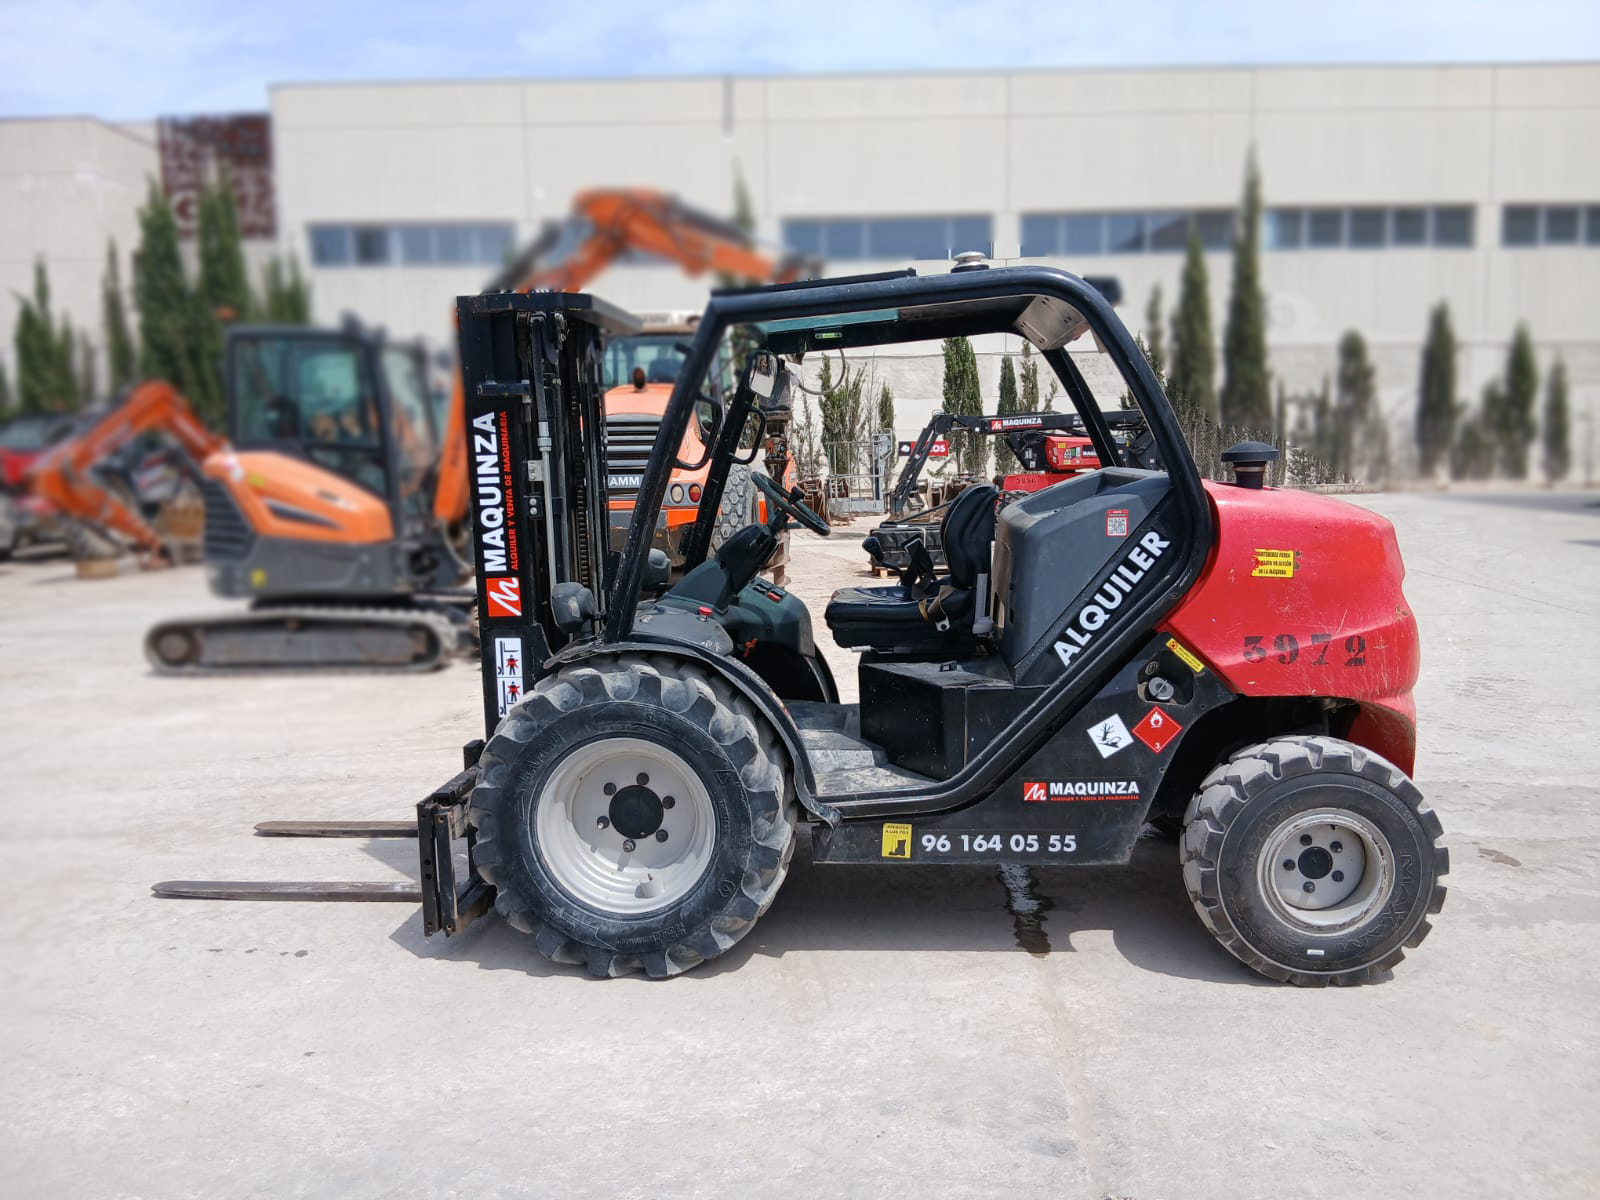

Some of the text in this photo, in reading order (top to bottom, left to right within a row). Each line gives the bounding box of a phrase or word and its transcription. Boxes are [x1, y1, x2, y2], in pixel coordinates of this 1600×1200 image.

[1003, 418, 1042, 426] MAQUINZA
[501, 412, 512, 472] MAQUINARIA
[473, 412, 506, 572] MAQUINZA
[504, 474, 512, 486] DE
[608, 476, 640, 486] AMM
[505, 488, 514, 518] VENTA
[508, 529, 518, 570] ALQUILER
[1053, 530, 1170, 666] ALQUILER
[1243, 634, 1366, 668] 3972
[1154, 742, 1160, 750] 3
[1050, 782, 1140, 796] MAQUINZA
[921, 834, 1076, 852] 96 164 05 55
